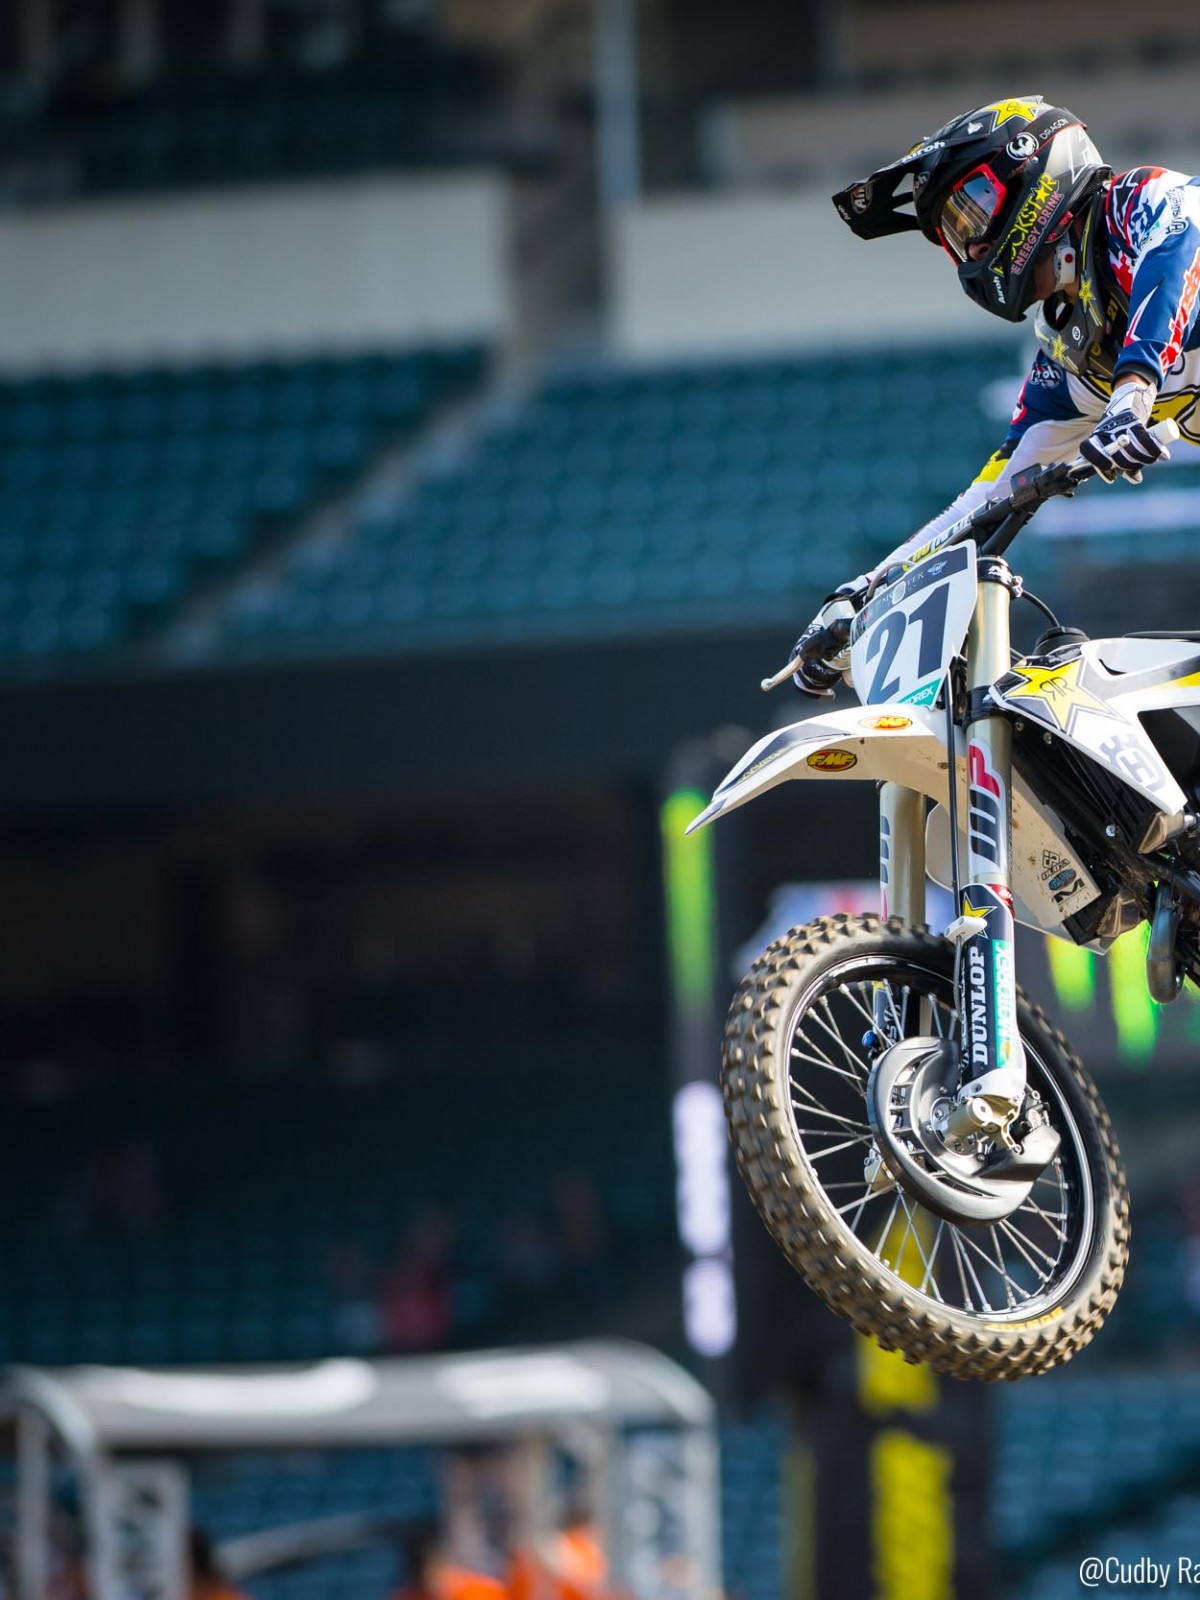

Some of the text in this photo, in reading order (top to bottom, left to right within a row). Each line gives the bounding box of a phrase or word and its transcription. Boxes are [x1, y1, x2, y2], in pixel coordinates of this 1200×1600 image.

[1039, 117, 1069, 140] DRAGON
[1010, 226, 1041, 275] ENERGY
[1037, 190, 1062, 227] DRINK
[866, 582, 951, 706] 21
[808, 751, 857, 767] FMF
[969, 946, 989, 1066] DUNLOP
